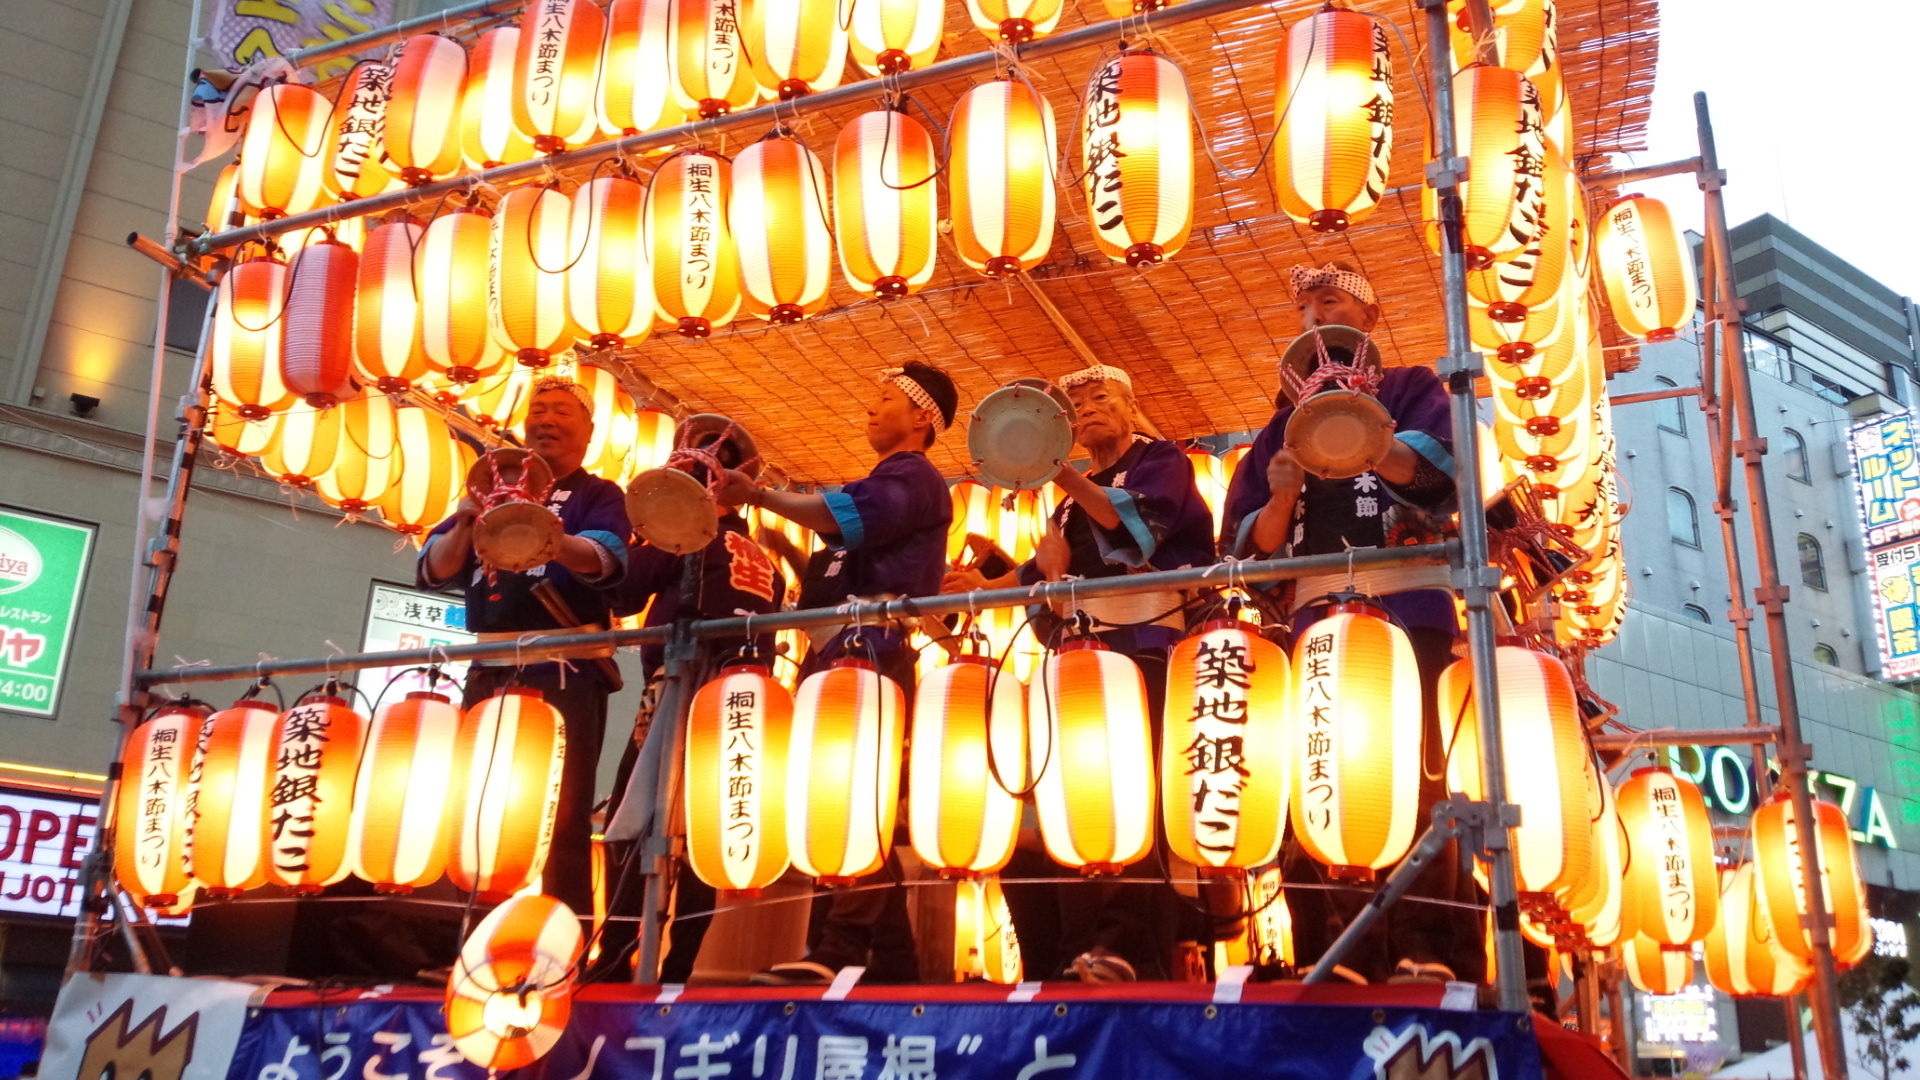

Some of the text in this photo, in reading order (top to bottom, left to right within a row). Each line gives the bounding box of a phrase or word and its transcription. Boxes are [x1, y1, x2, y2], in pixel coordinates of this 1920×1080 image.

[532, 0, 570, 105] 生八木節まつり
[712, 0, 736, 75] 木節まつり
[687, 163, 713, 290] 桐生八木節まつり
[1863, 456, 1899, 526] ルーム
[1876, 543, 1920, 568] 受付5
[0, 680, 48, 702] 4:00
[1180, 639, 1256, 852] 築地銀だこ
[1306, 633, 1334, 831] 桐生八木節まつり
[141, 728, 178, 868] 桐生八木節まつり
[268, 707, 332, 872] 築地銀だこ
[725, 690, 755, 862] 桐生八木節まつり
[1651, 787, 1691, 922] 桐生八木節まつり
